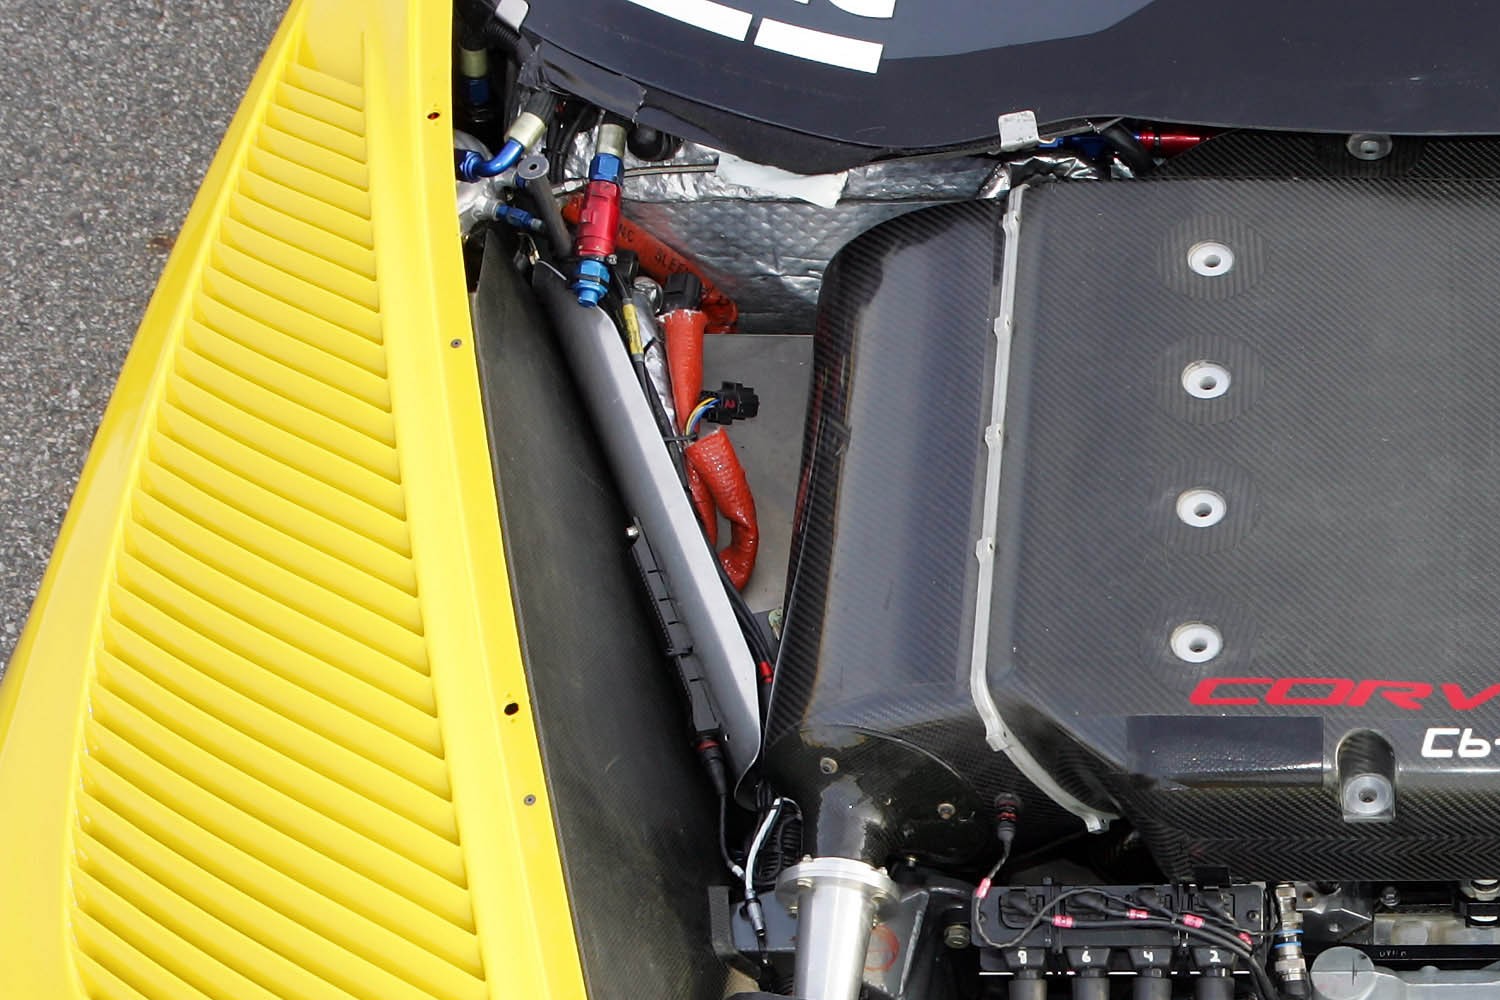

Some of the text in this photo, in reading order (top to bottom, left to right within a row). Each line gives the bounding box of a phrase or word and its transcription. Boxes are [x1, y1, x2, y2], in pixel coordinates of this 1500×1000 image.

[1081, 950, 1092, 964] 6
[1143, 951, 1155, 964] 4
[1209, 951, 1221, 964] 2
